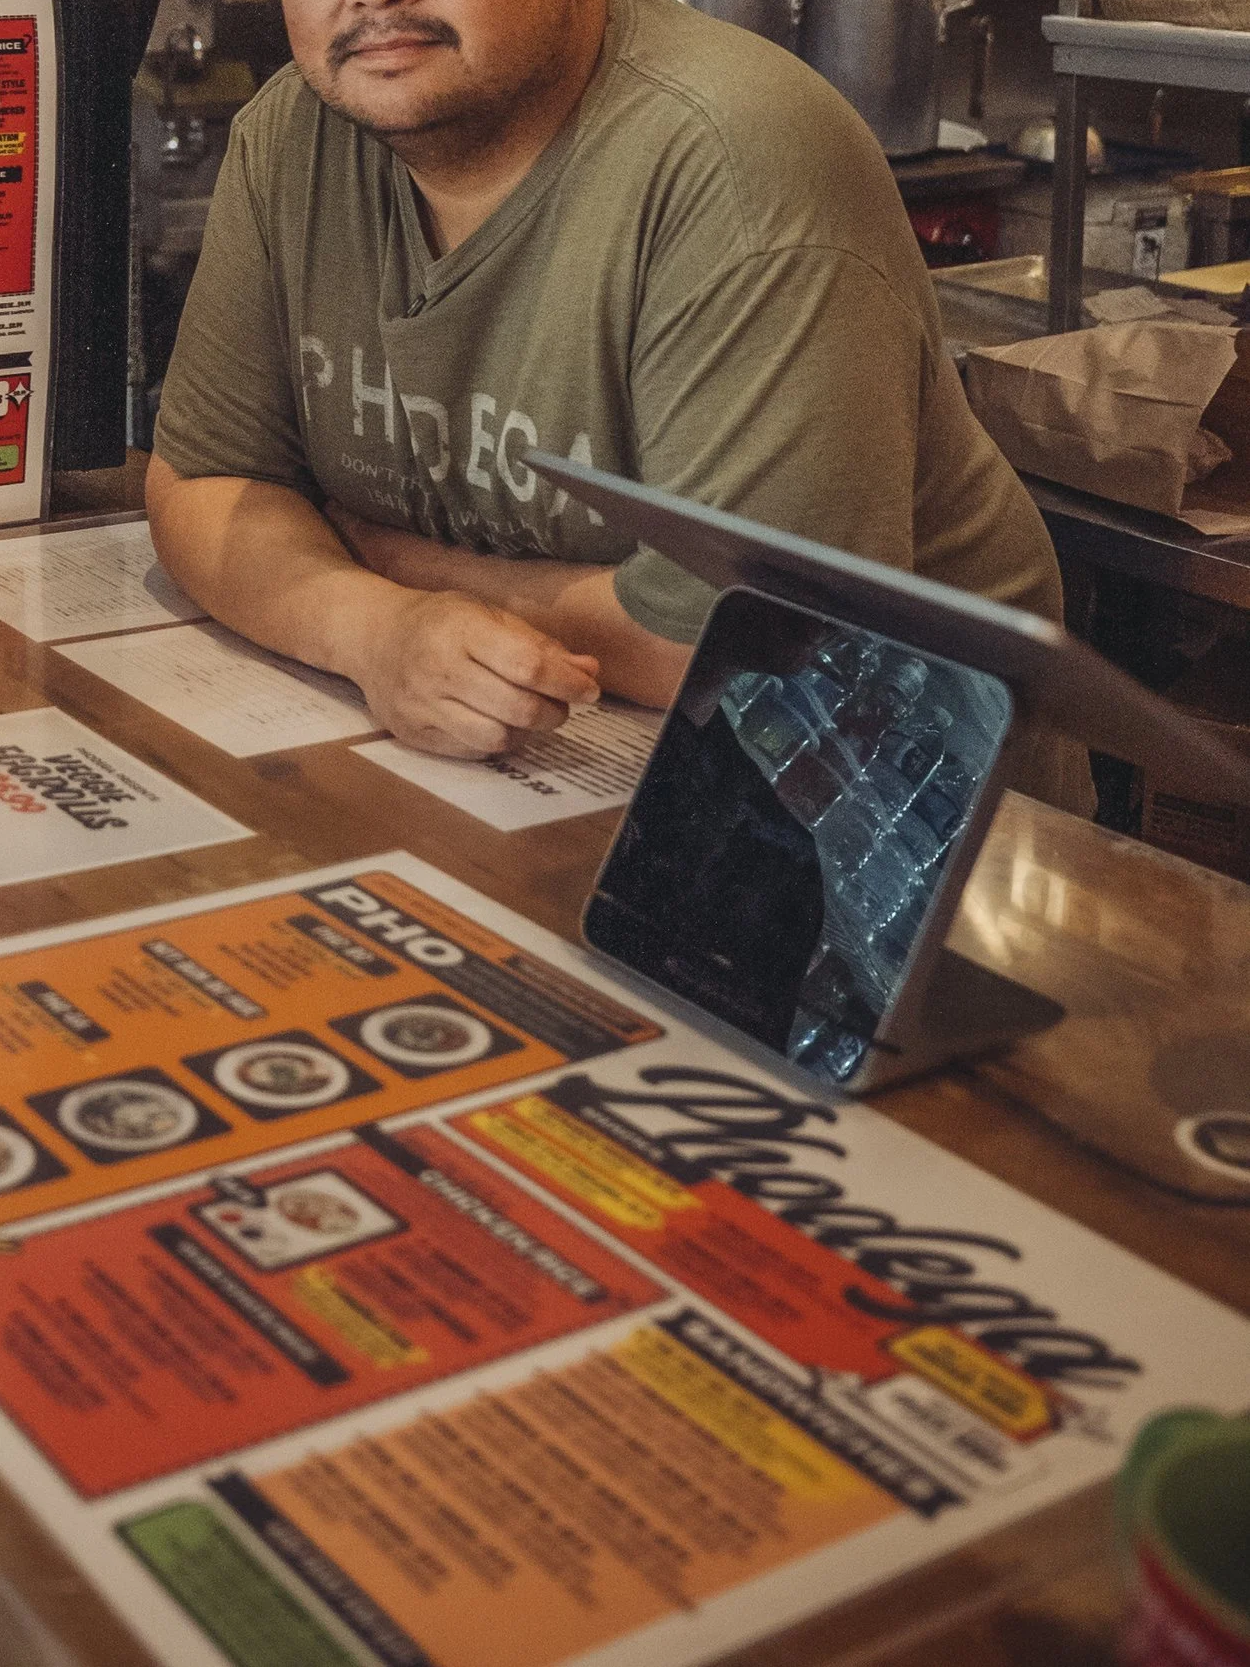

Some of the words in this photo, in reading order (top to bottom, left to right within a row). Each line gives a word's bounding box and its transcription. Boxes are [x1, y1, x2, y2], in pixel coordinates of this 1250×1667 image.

[1, 79, 25, 89] STYLE
[299, 335, 604, 527] PHDEGA
[311, 885, 477, 969] PHO
[550, 1065, 1143, 1390] Phodega
